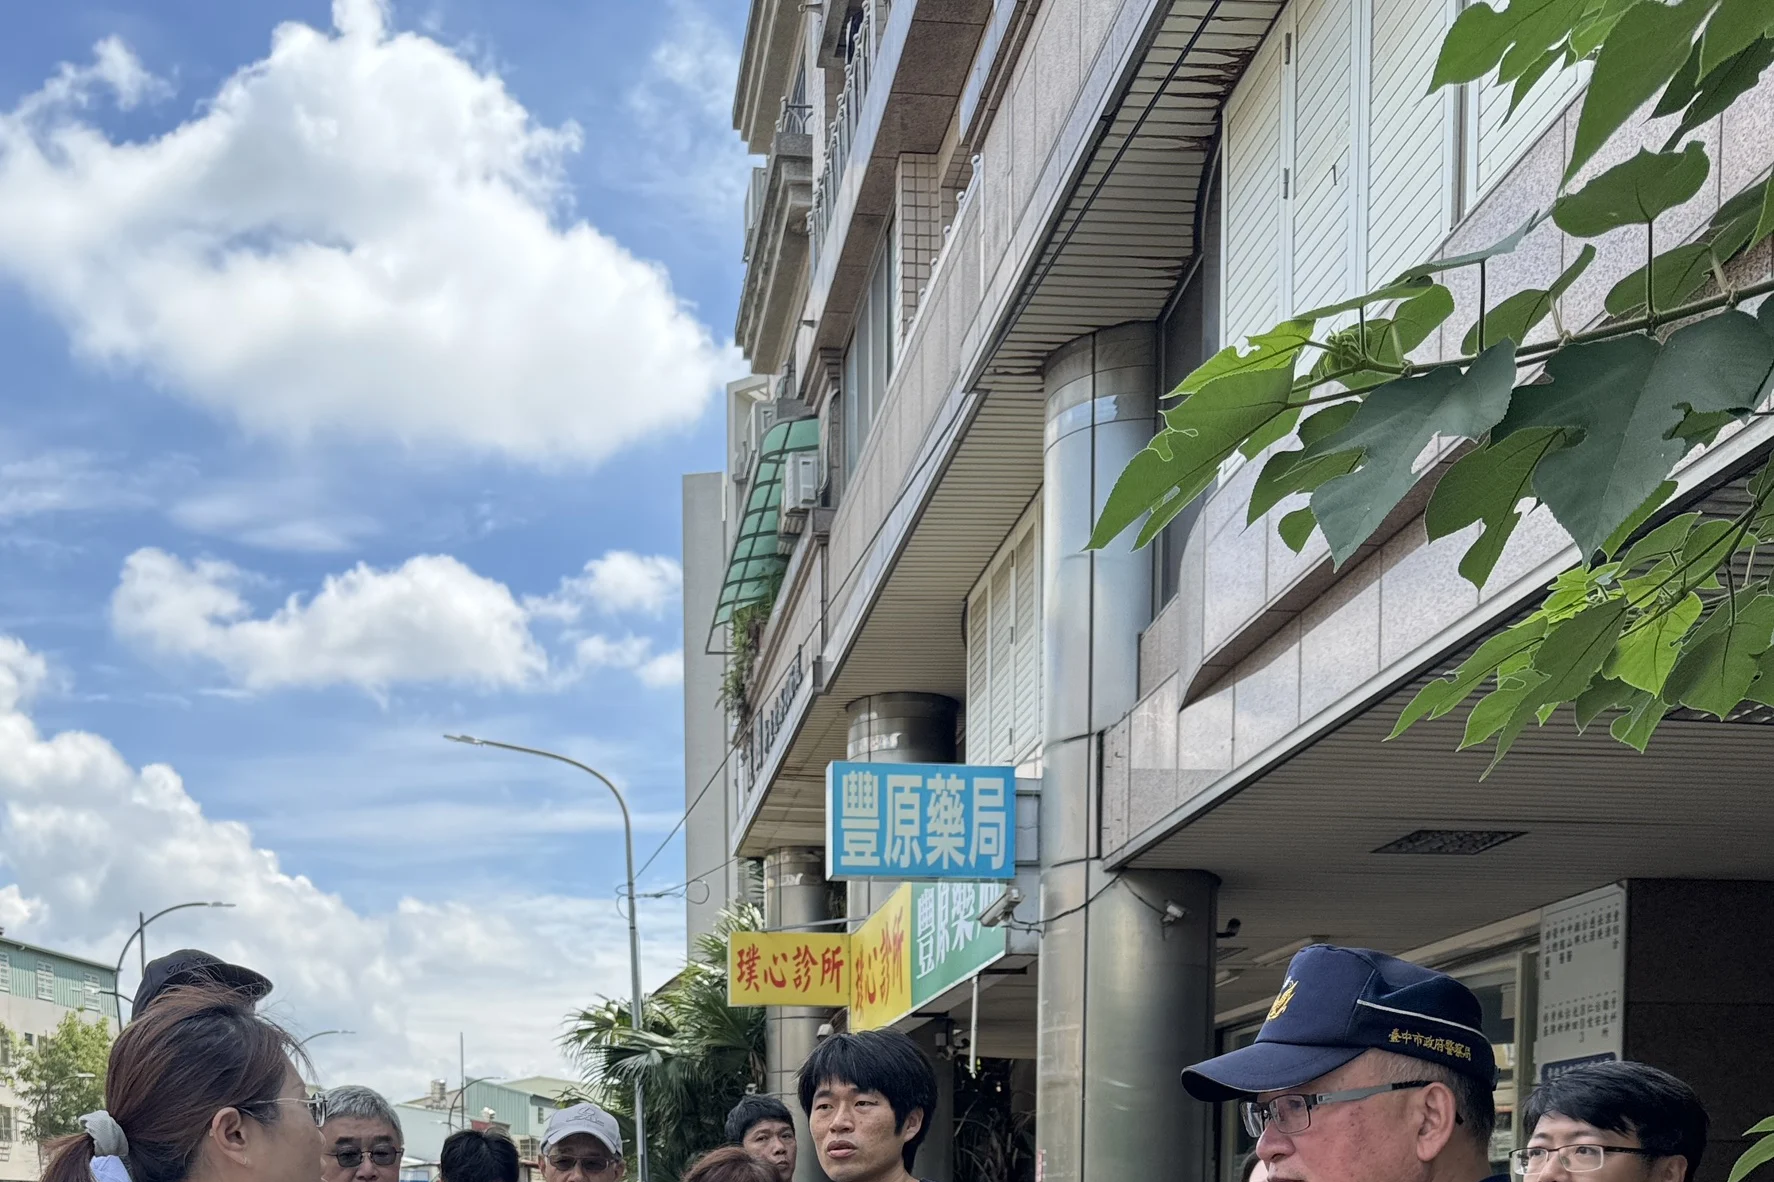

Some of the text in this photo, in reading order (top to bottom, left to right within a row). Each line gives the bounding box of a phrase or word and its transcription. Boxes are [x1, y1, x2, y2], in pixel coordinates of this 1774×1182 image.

[840, 769, 1007, 870] 豐原藥局
[736, 944, 845, 994] 璞心診所
[1388, 1027, 1472, 1062] 臺中市政府警察局
